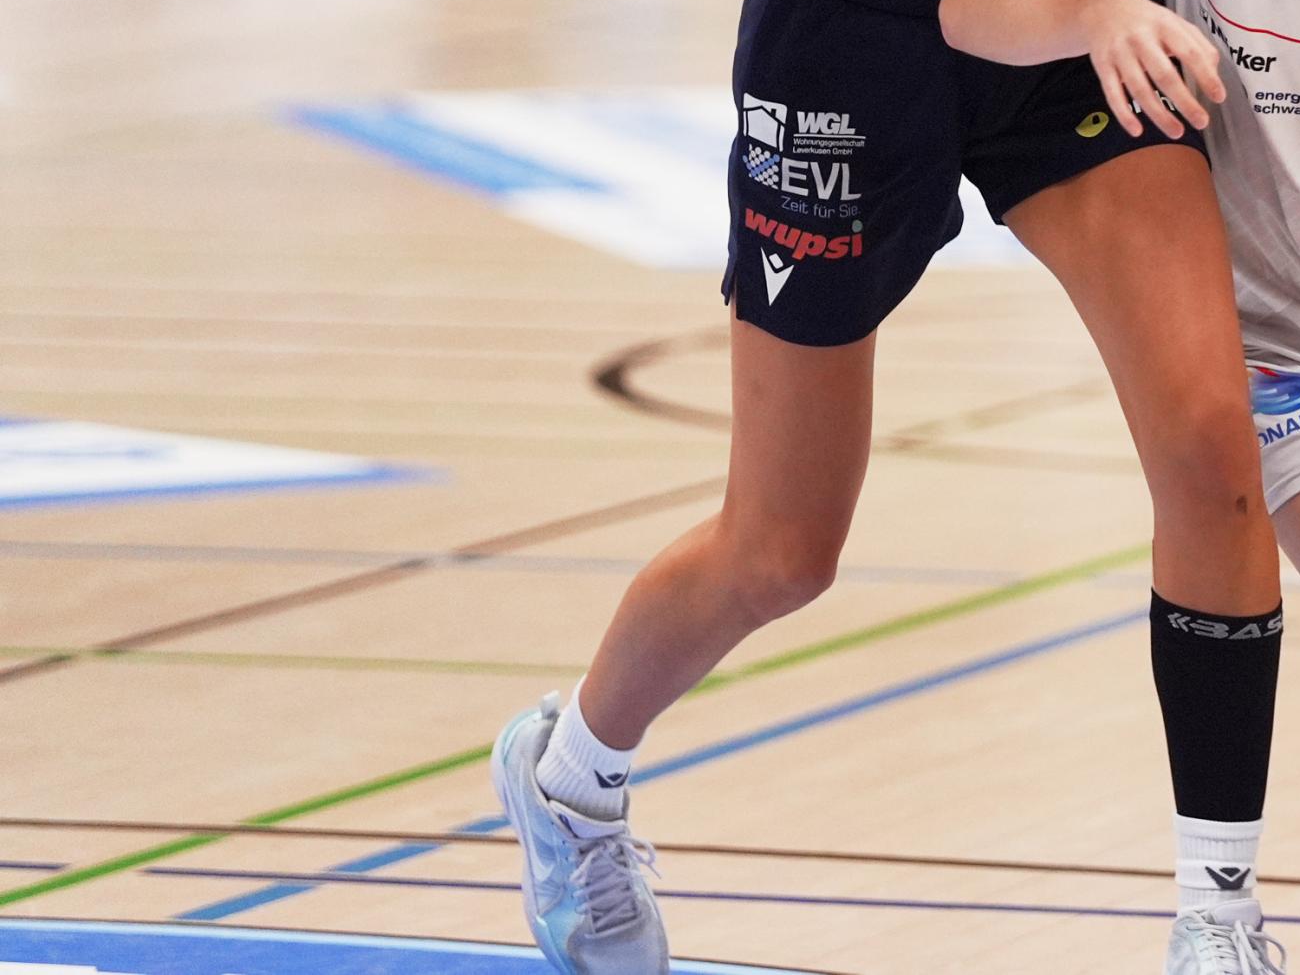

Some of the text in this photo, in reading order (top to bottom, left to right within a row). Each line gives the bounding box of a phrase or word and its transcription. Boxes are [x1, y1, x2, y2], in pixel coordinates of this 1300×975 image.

[796, 111, 856, 135] WGL
[792, 146, 853, 156] Leverkusen GmbH
[781, 156, 863, 201] EVL
[781, 195, 809, 215] Zeit
[813, 203, 836, 218] für
[745, 208, 863, 261] wupsi
